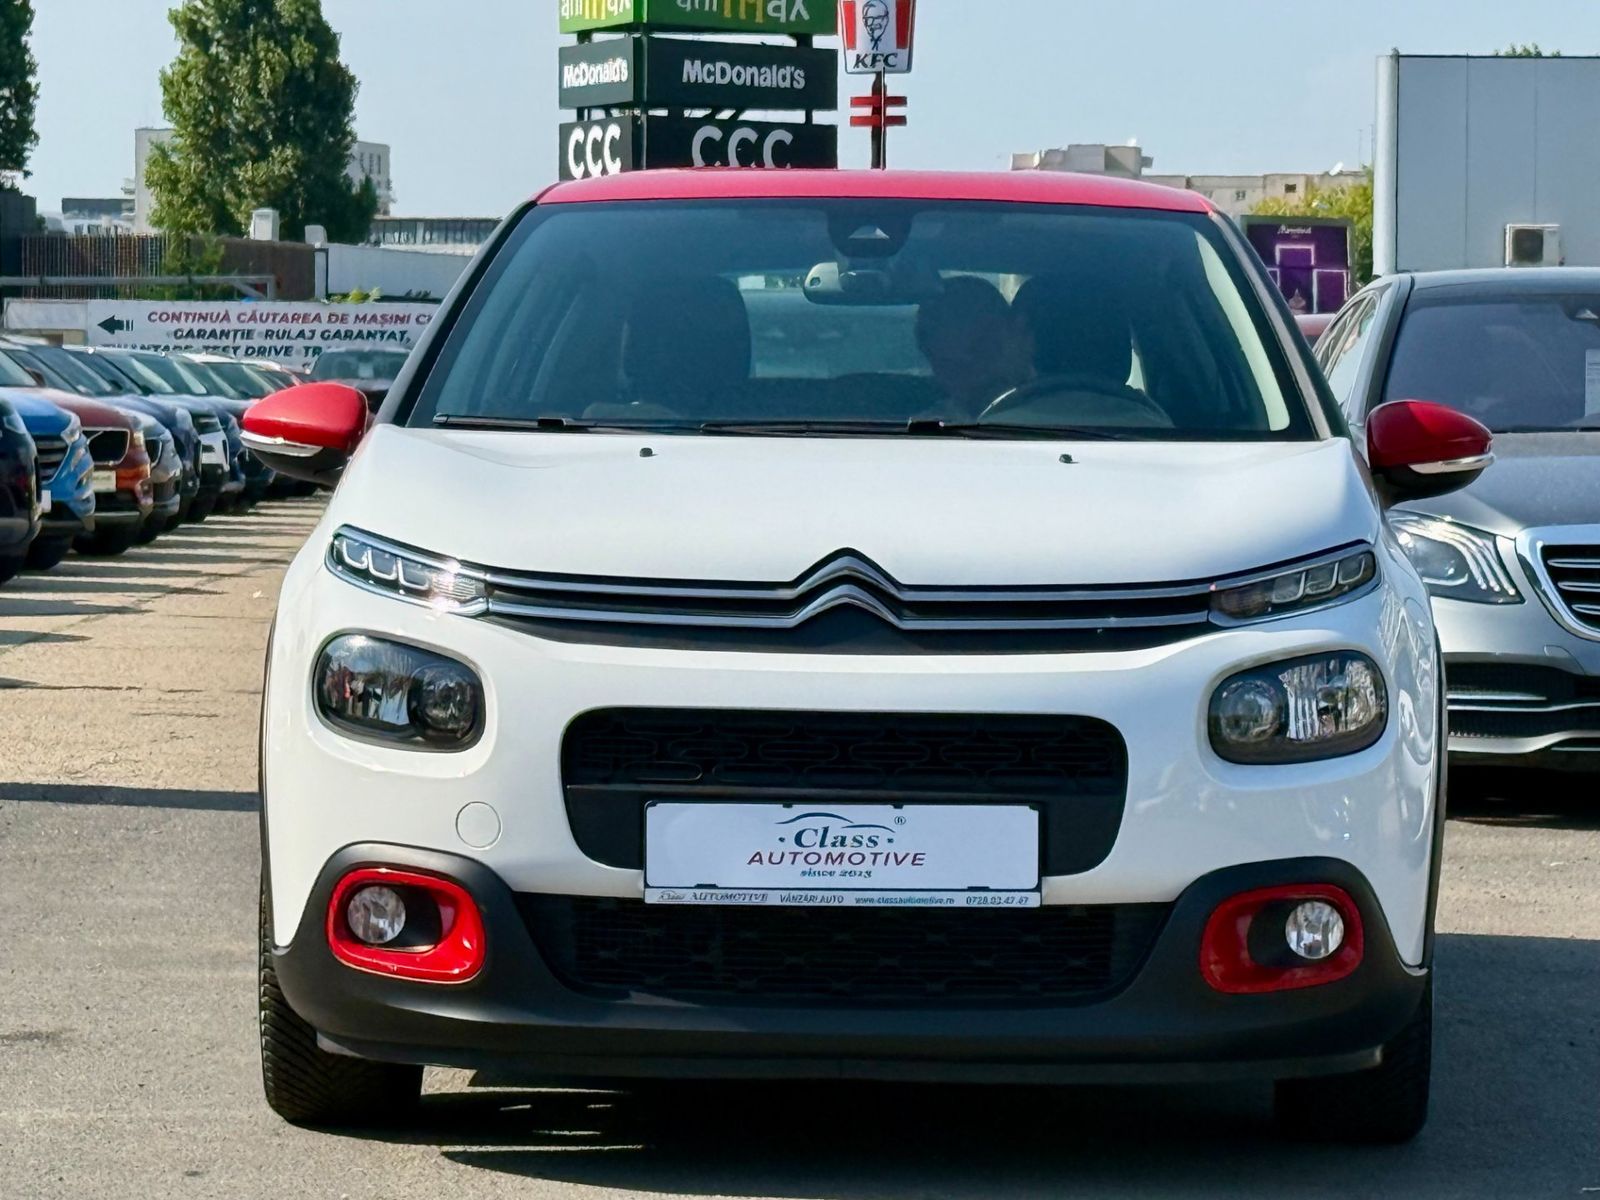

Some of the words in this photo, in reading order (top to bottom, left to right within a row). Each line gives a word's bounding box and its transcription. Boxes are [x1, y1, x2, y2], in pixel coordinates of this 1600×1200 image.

[853, 53, 898, 69] KFC
[563, 57, 628, 88] McDonald's
[682, 59, 806, 89] McDonald's
[568, 123, 622, 179] CCC
[691, 125, 794, 168] CCC
[236, 309, 322, 325] CĂUTAREA
[327, 313, 349, 325] DE
[264, 328, 316, 341] RULAJ
[243, 345, 294, 357] DRIVE
[794, 825, 880, 848] Class
[747, 851, 927, 866] AUTOMOTIVE
